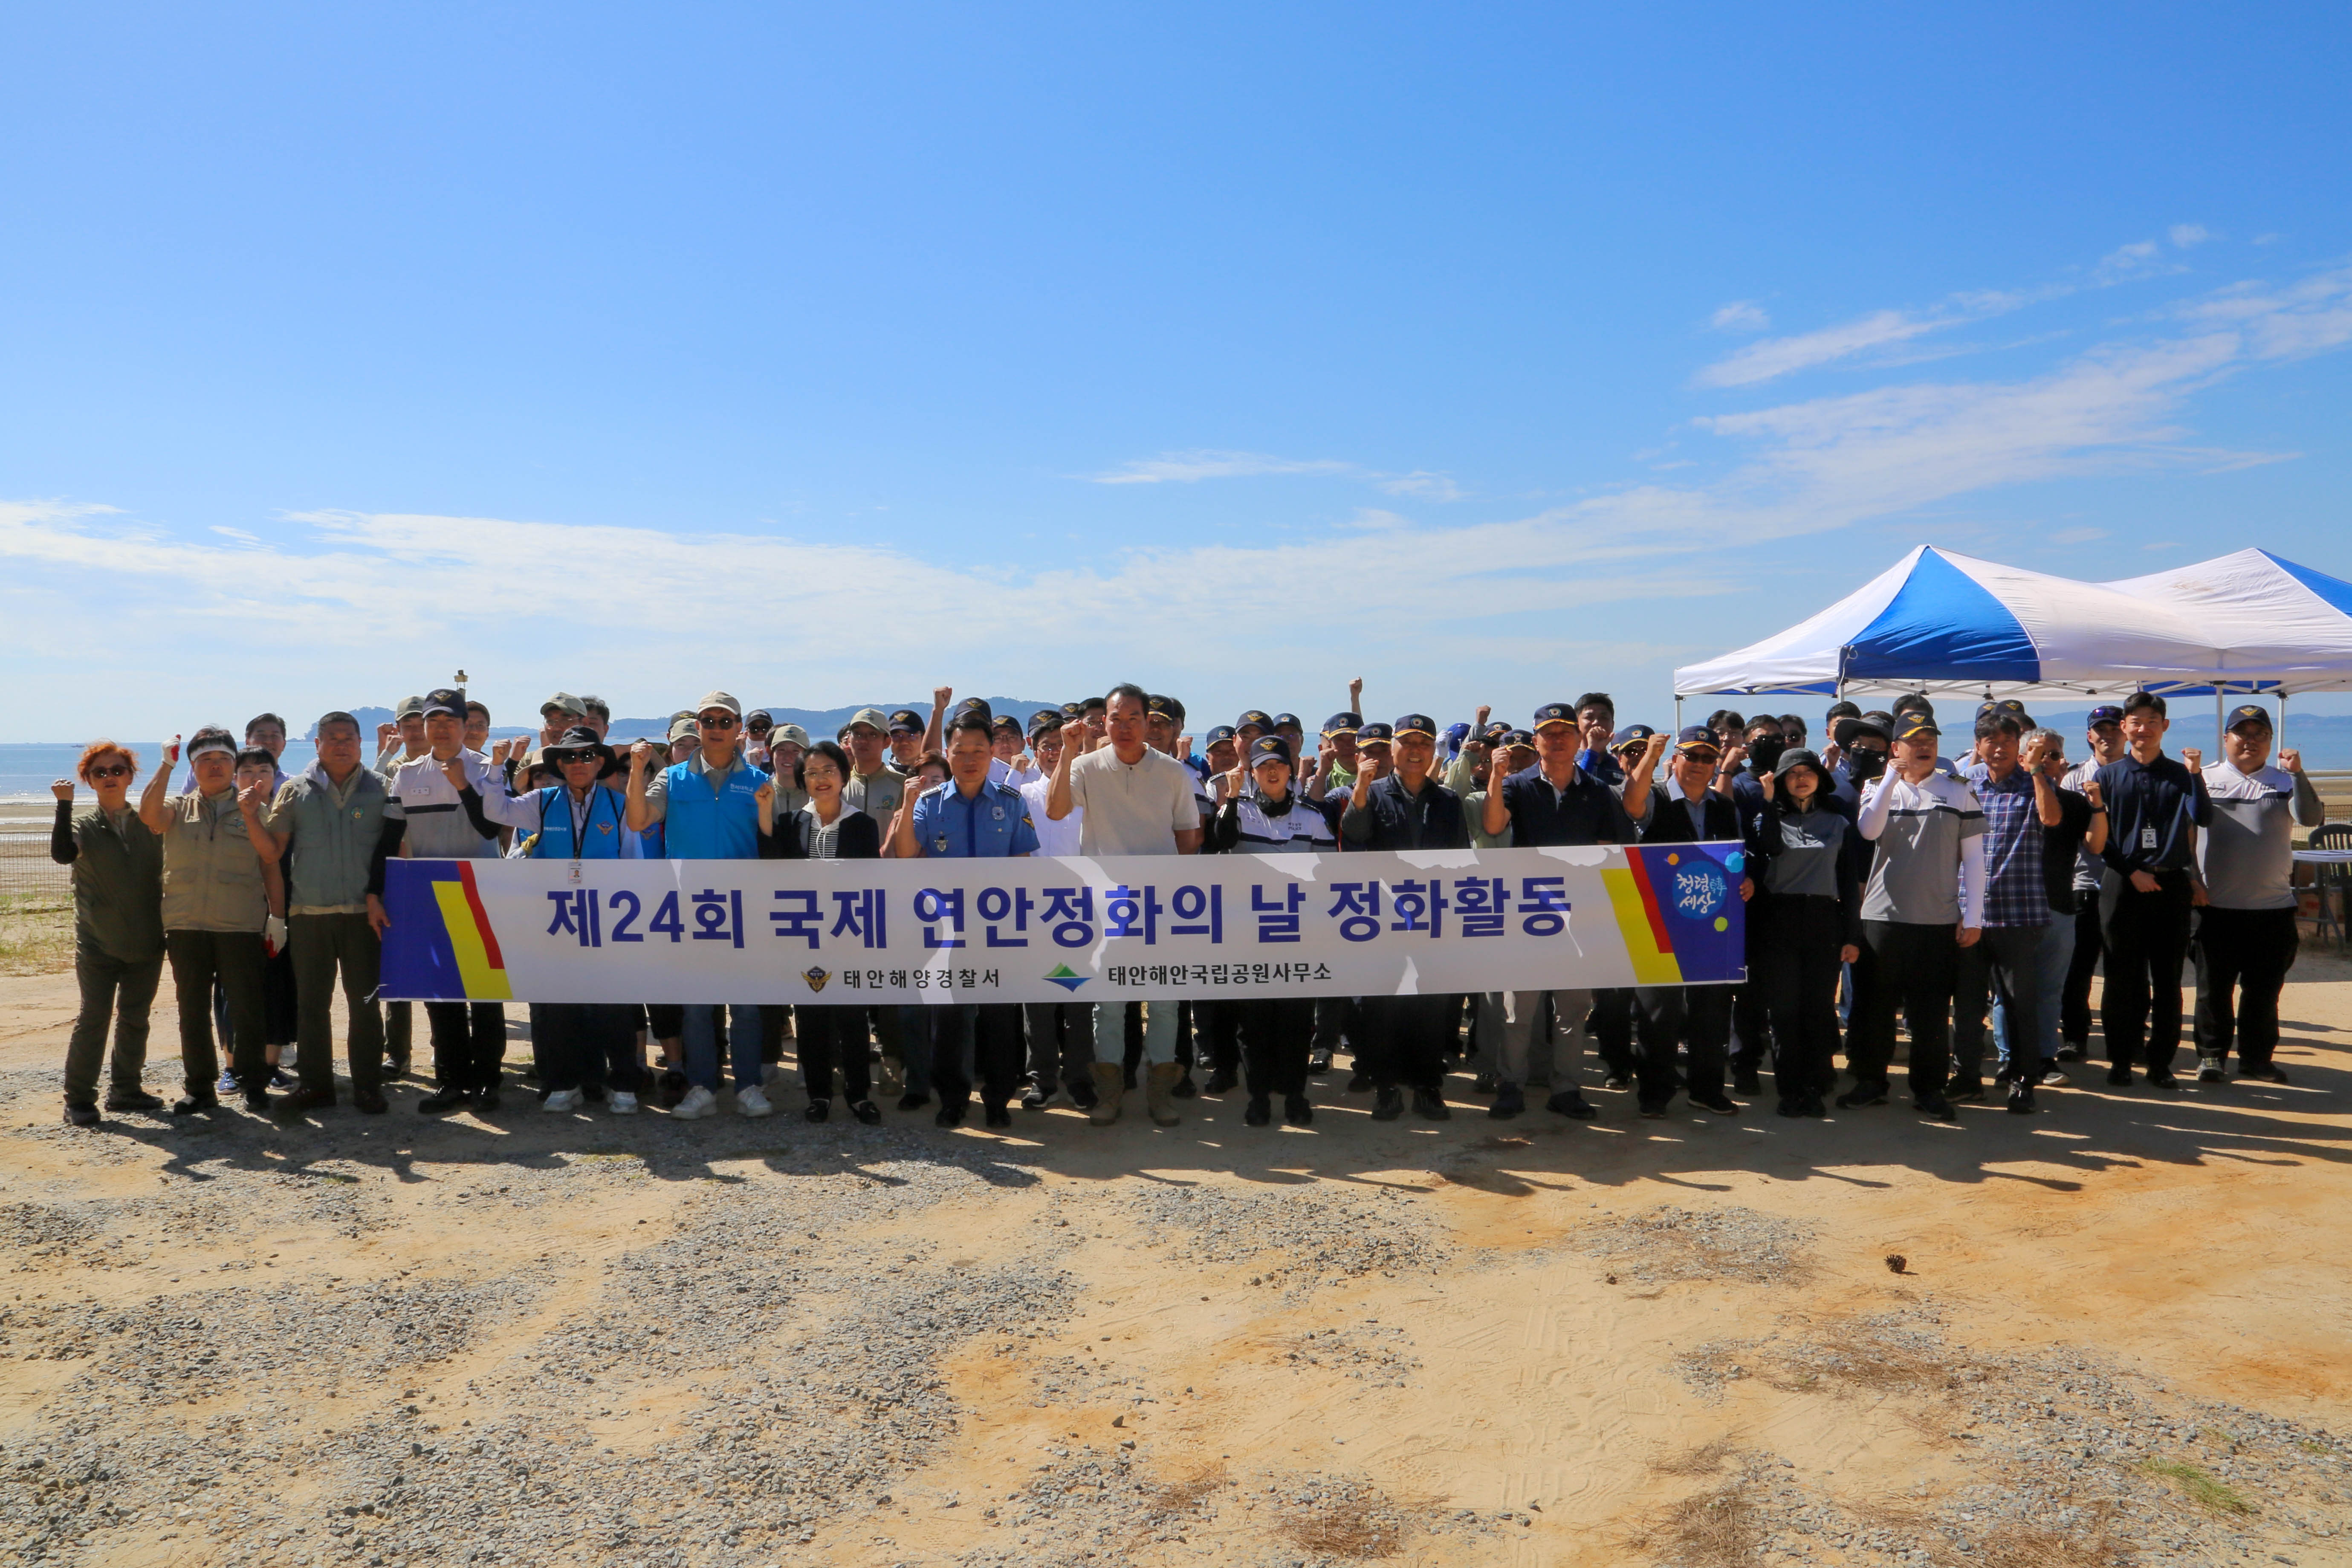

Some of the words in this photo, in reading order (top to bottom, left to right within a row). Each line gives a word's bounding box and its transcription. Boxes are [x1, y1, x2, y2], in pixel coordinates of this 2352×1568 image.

[547, 888, 745, 949] 제24회
[770, 889, 887, 949] 국제
[913, 884, 1223, 949] 연안정화의
[1251, 882, 1306, 943] 날
[1327, 877, 1571, 942] 정화활동
[1679, 892, 1716, 914] 세상
[843, 968, 999, 989] 태안해양경찰서
[1108, 962, 1332, 986] 태안해안국립공원사무소
